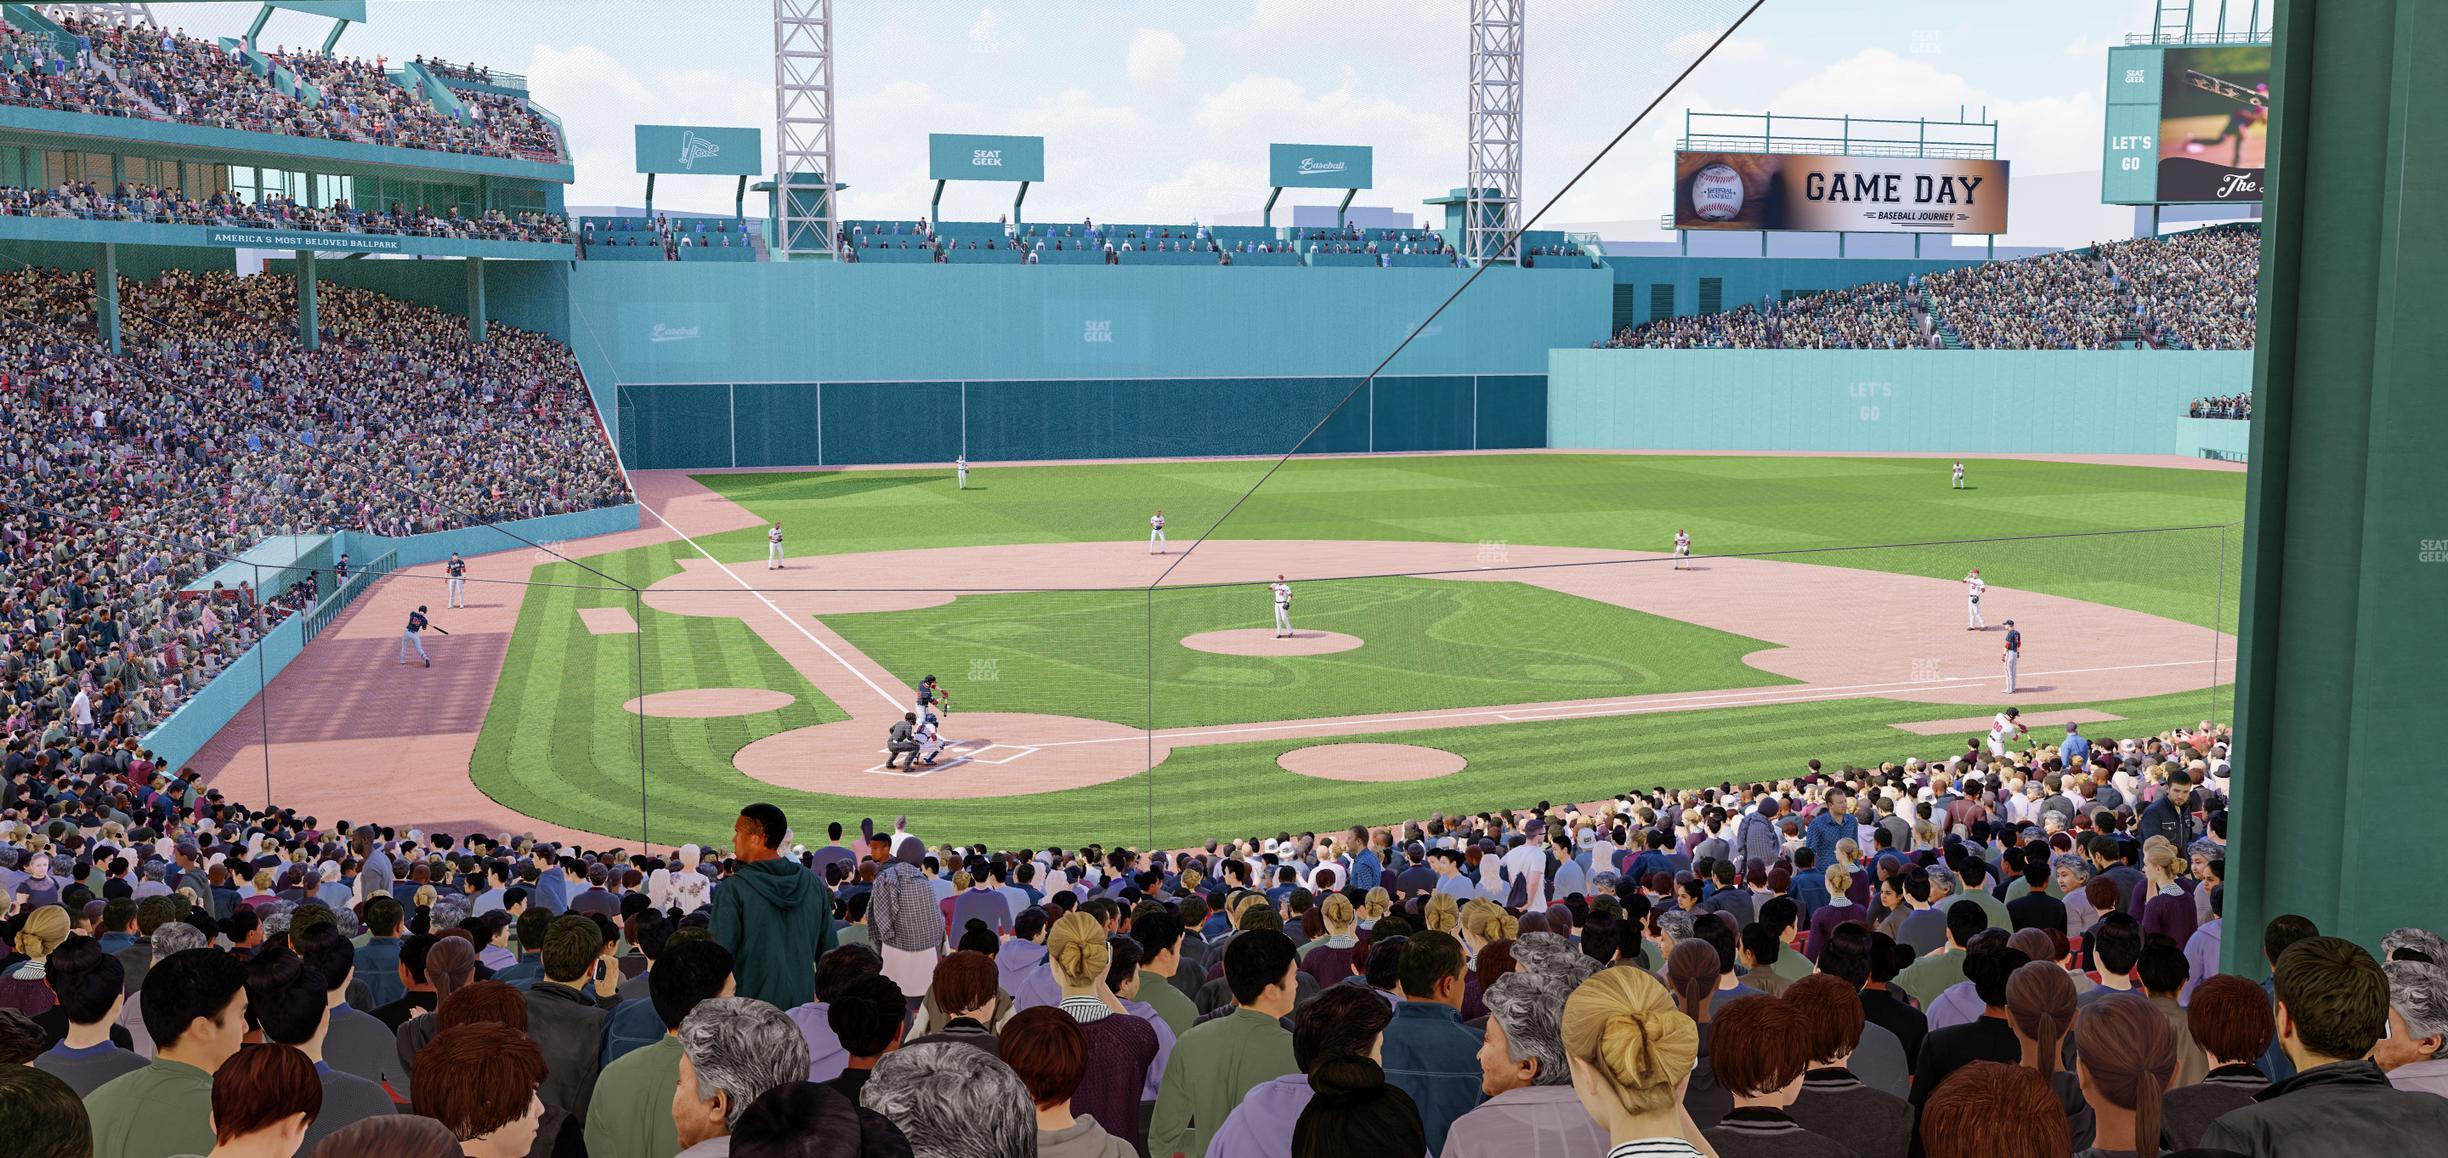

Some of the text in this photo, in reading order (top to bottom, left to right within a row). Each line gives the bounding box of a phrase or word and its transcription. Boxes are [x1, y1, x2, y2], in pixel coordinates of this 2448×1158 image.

[2126, 69, 2145, 77] SEAT
[2112, 135, 2152, 150] LET'S
[973, 150, 1001, 158] SEAT
[972, 158, 1002, 167] GEEK
[1298, 158, 1346, 172] Baseball
[2122, 157, 2140, 171] GO
[1805, 171, 1983, 206] GAME DAY
[2217, 172, 2256, 198] The
[1878, 211, 1954, 221] BASEBALL JOURNEY
[214, 234, 272, 243] AMERICA'S
[305, 238, 348, 247] BELOVED
[350, 240, 397, 249] BALLPARK
[1085, 321, 1111, 331] SEAT
[1083, 331, 1112, 342] GEEK
[1849, 382, 1892, 398] LET'S
[1860, 406, 1880, 421] GO
